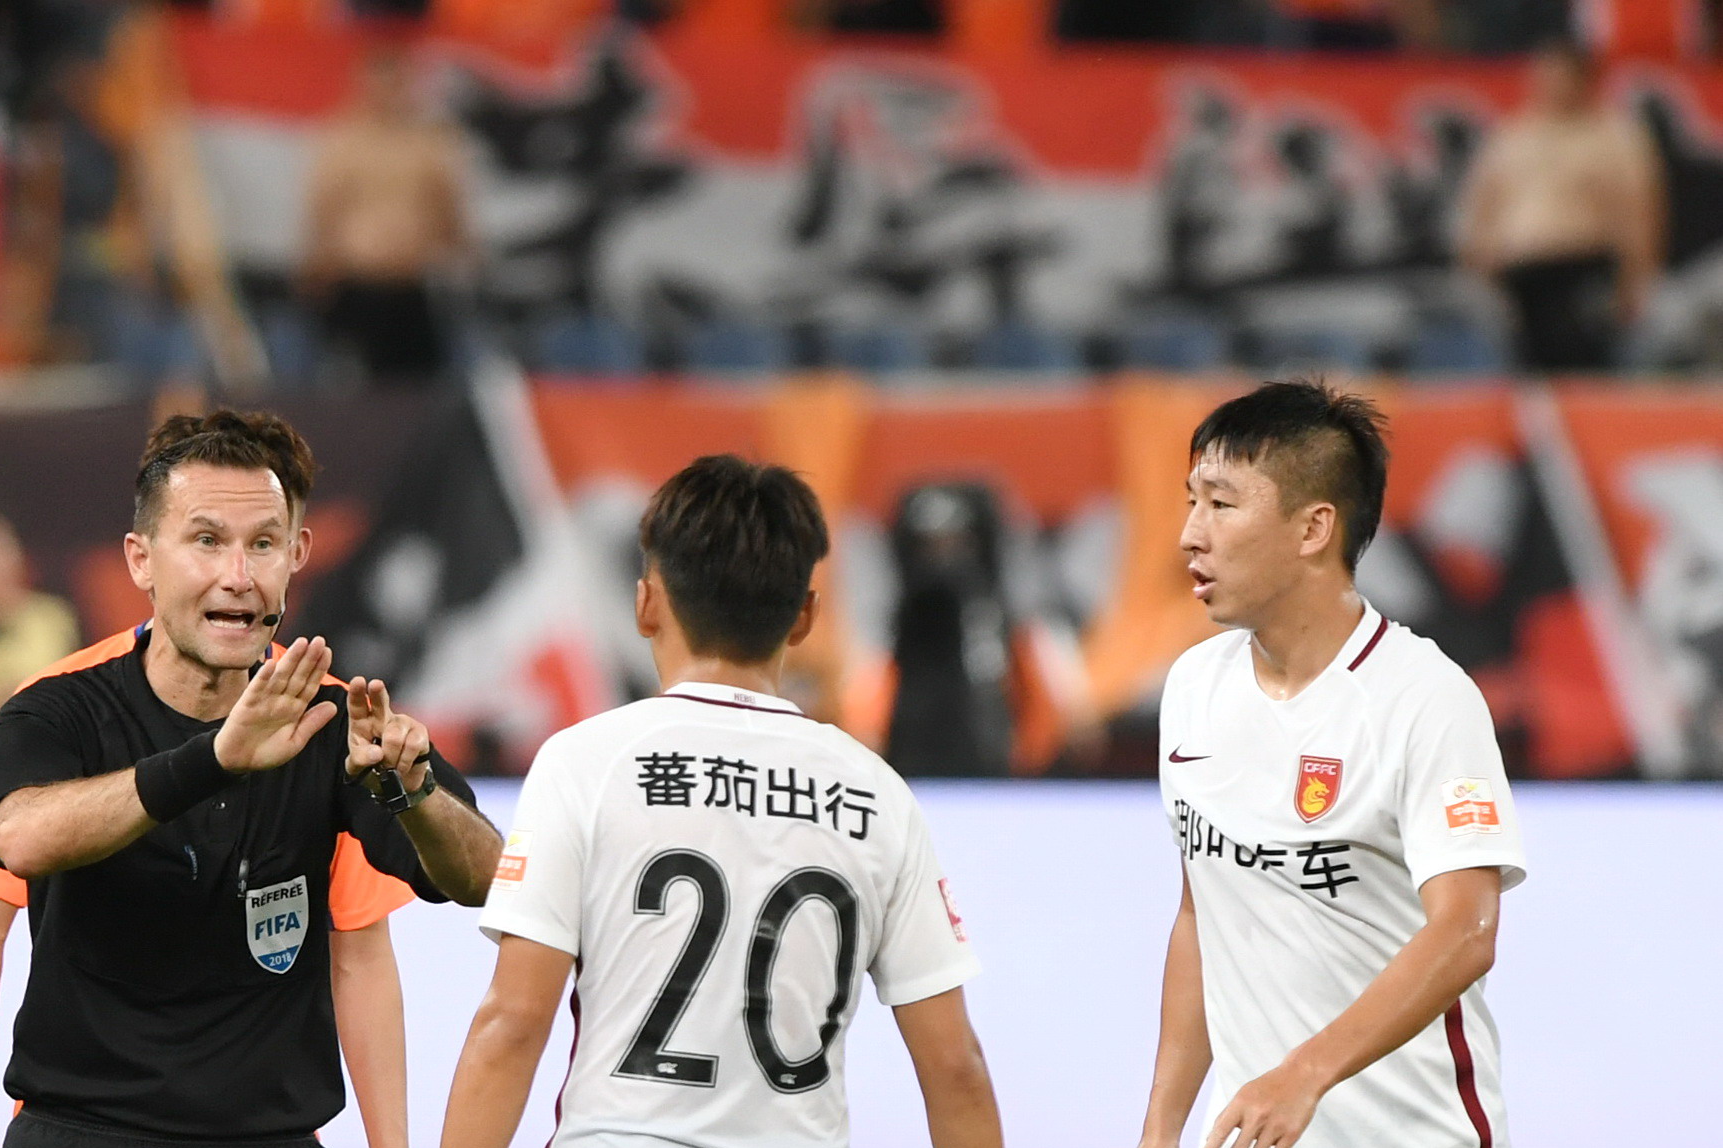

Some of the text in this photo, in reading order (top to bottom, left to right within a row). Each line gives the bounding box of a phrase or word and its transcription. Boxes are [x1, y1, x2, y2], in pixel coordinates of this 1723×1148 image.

[1304, 763, 1338, 776] CFFC
[635, 751, 878, 841] 蕃茄出行
[251, 883, 304, 909] REFEREE
[255, 911, 301, 941] FIFA
[269, 952, 292, 967] 2018
[611, 848, 860, 1094] 20
